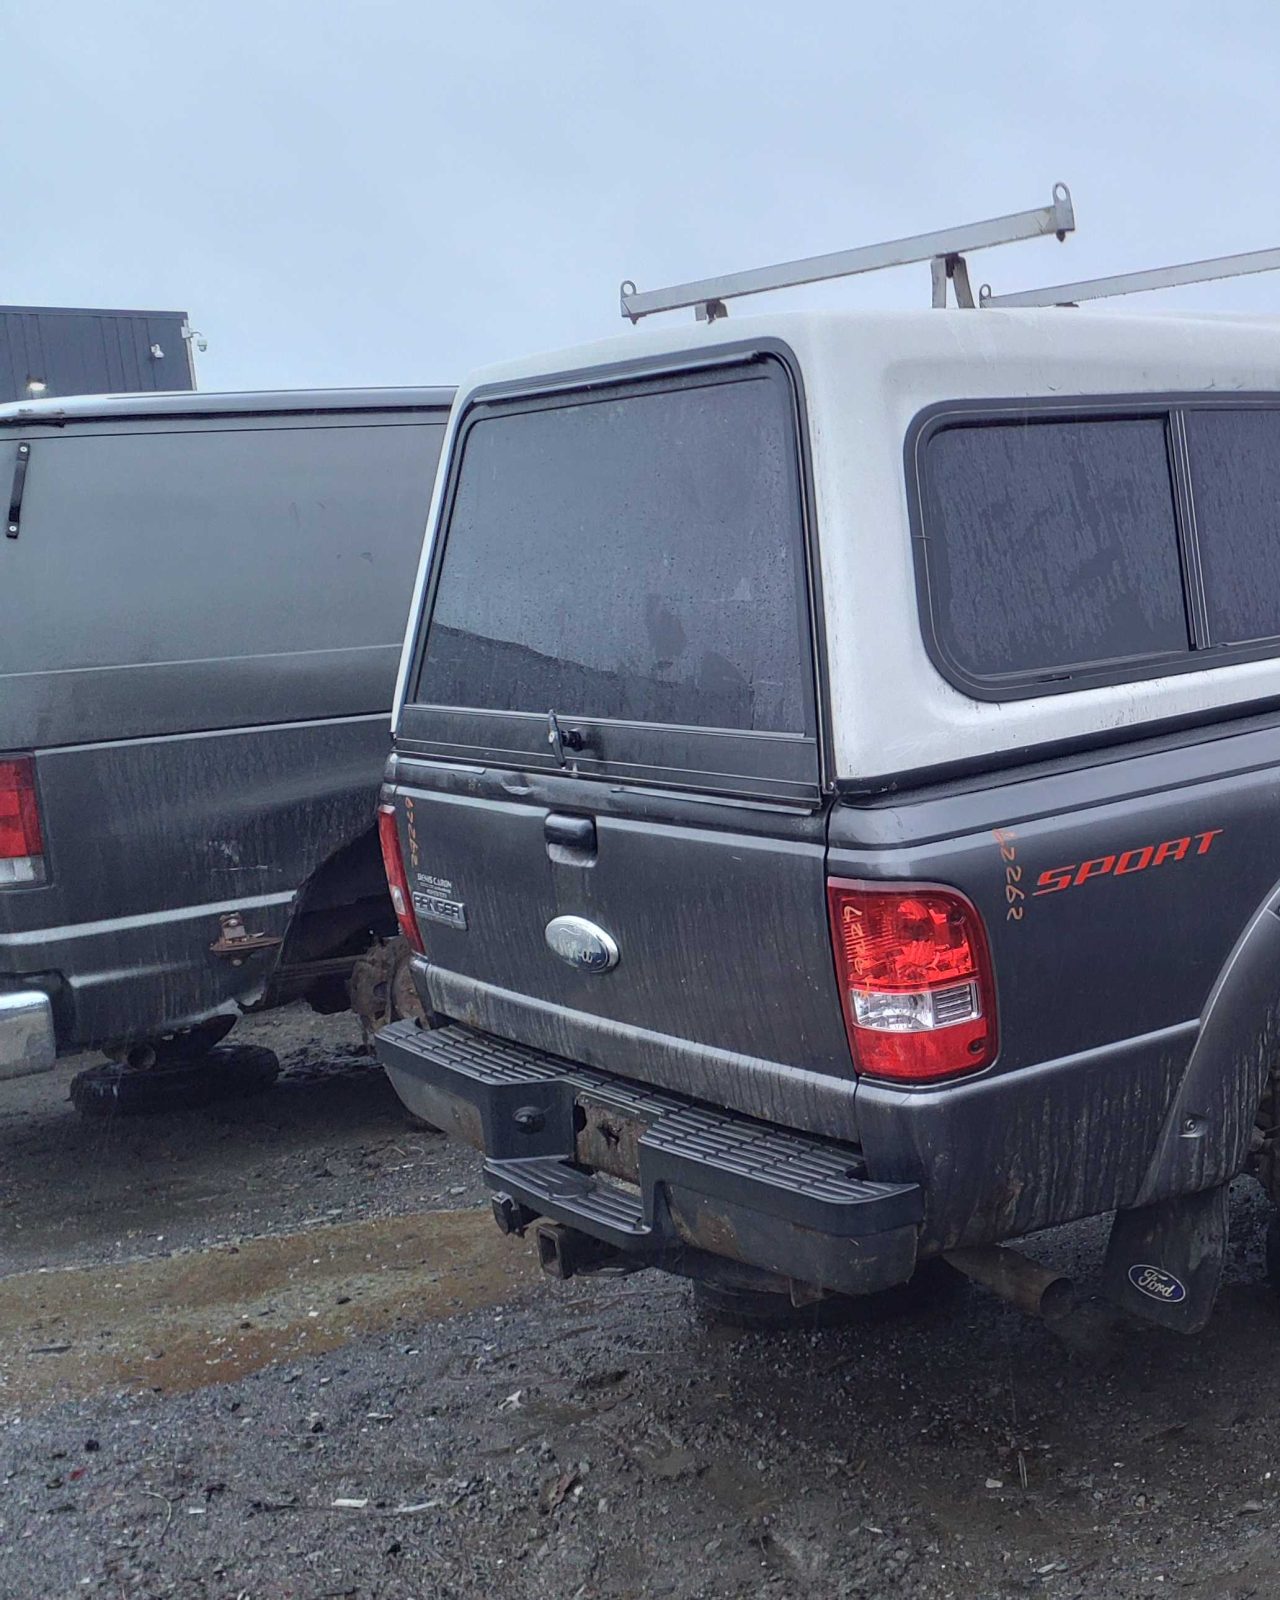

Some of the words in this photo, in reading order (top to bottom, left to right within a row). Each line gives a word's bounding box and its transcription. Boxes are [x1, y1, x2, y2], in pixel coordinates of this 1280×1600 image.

[1032, 829, 1223, 896] SPORT
[414, 894, 461, 919] RANGER
[1138, 1269, 1176, 1297] Ford
